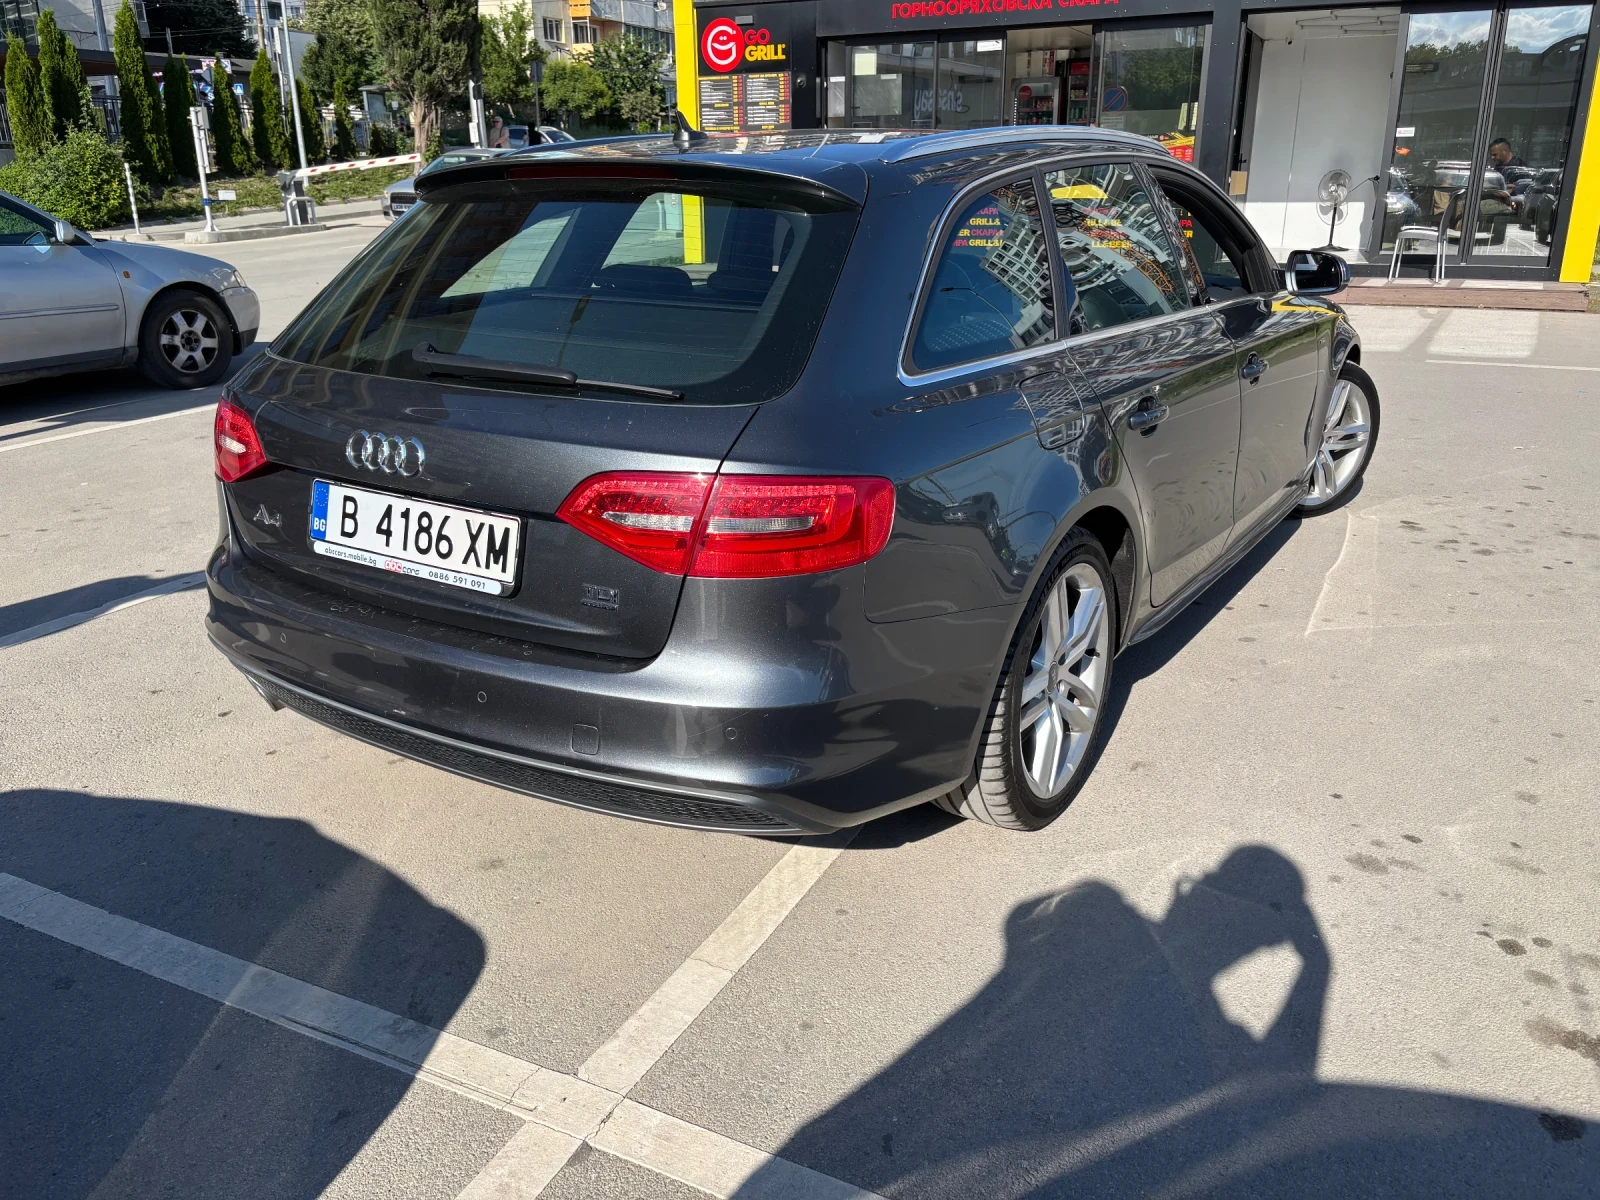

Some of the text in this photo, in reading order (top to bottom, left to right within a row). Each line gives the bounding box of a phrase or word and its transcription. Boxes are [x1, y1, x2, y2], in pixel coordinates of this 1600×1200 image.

[891, 0, 1053, 19] ГОРНООРЯХОВСКА
[744, 28, 771, 45] GO
[253, 503, 283, 528] A4
[313, 517, 326, 532] BG
[340, 494, 511, 574] B 4186 XM
[324, 547, 377, 567] abccars.mobile.bg
[428, 570, 450, 582] 0886
[453, 575, 468, 586] 591
[471, 580, 486, 590] 091
[581, 583, 620, 604] TDI
